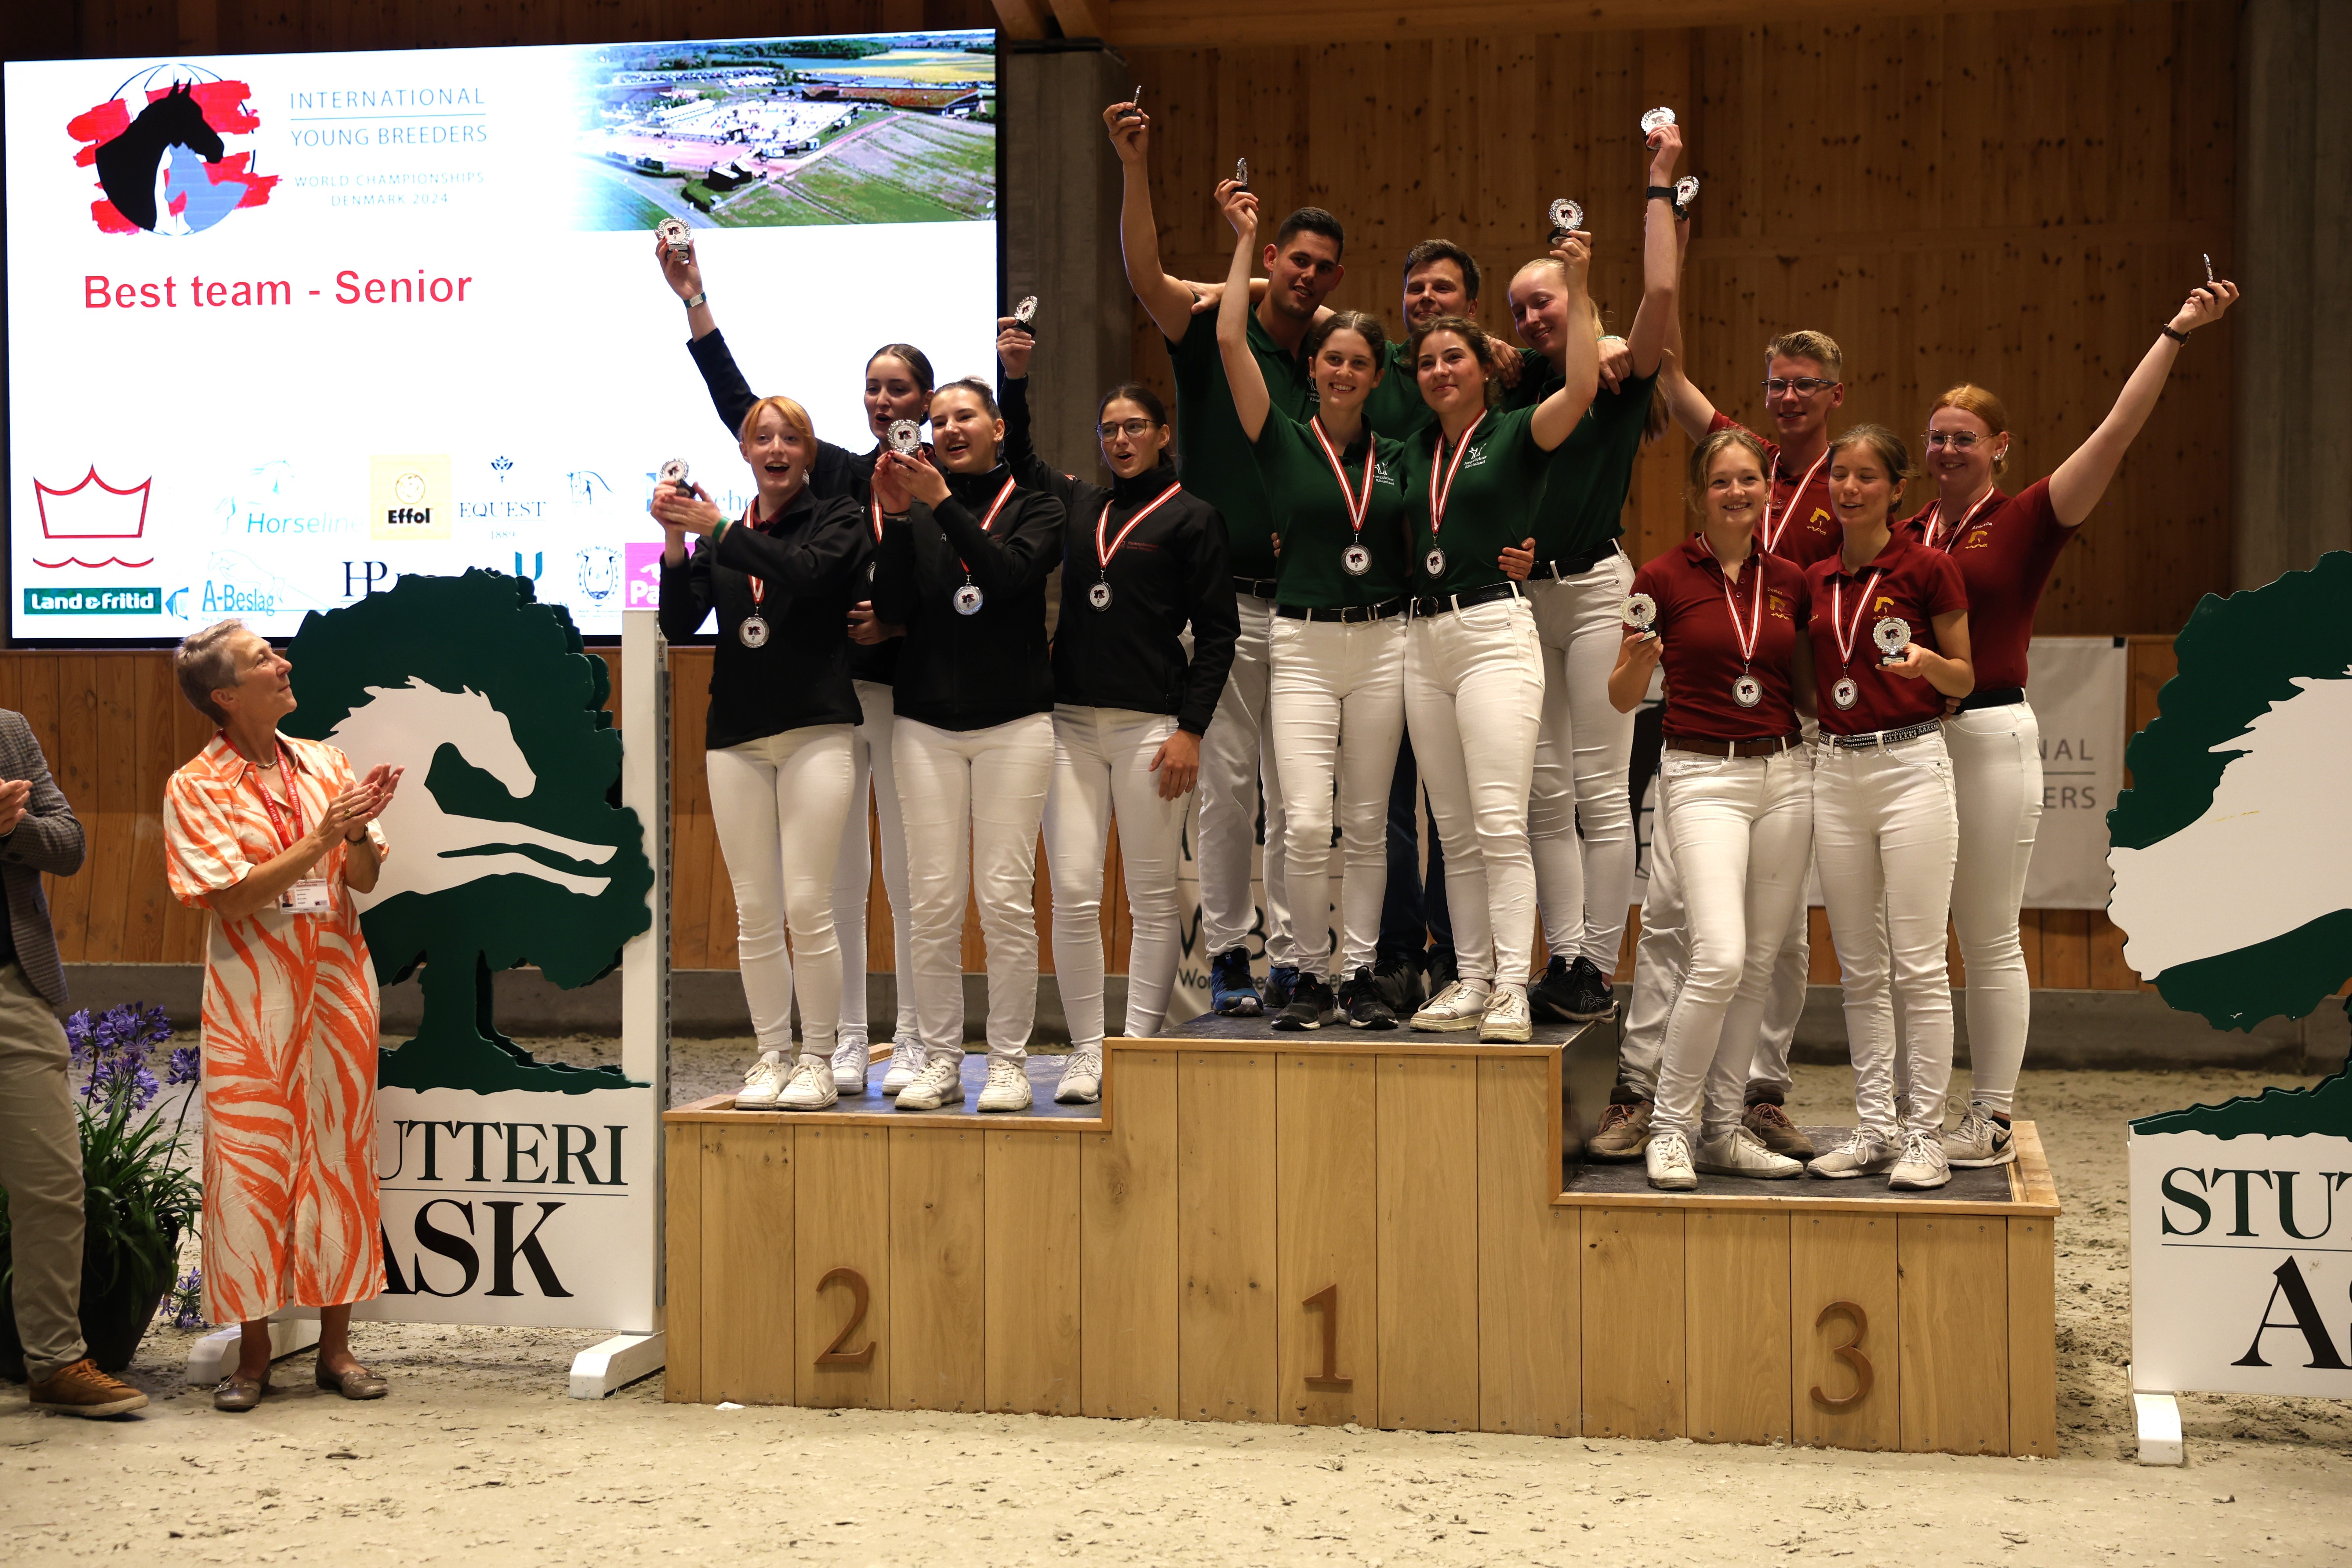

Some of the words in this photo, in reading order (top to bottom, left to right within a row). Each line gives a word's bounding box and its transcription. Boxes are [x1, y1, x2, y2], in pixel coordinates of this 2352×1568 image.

[290, 87, 485, 109] INTERNATIONAL
[290, 128, 369, 147] YOUNG
[379, 125, 487, 145] BREEDERS
[295, 175, 350, 187] WORLD
[356, 172, 485, 186] CHAMPIONSHIPS
[331, 194, 406, 207] DENMARK
[413, 193, 448, 205] 2024
[85, 276, 177, 309] Best
[191, 275, 290, 307] team
[335, 269, 473, 305] Senior
[1465, 460, 1485, 469] Rheinland
[388, 508, 430, 524] Effol
[459, 501, 546, 518] EQUEST
[247, 512, 365, 534] Horseline
[31, 593, 81, 610] Land
[202, 580, 275, 616] A-Beslag
[270, 808, 279, 822] DANISH
[292, 795, 301, 816] BREEDERS
[377, 1120, 628, 1186] UTTERI
[2161, 1167, 2352, 1240] STU
[813, 1267, 877, 1367] 2
[2231, 1255, 2352, 1370] A
[1302, 1283, 1352, 1385] 1
[1810, 1301, 1874, 1406] 3
